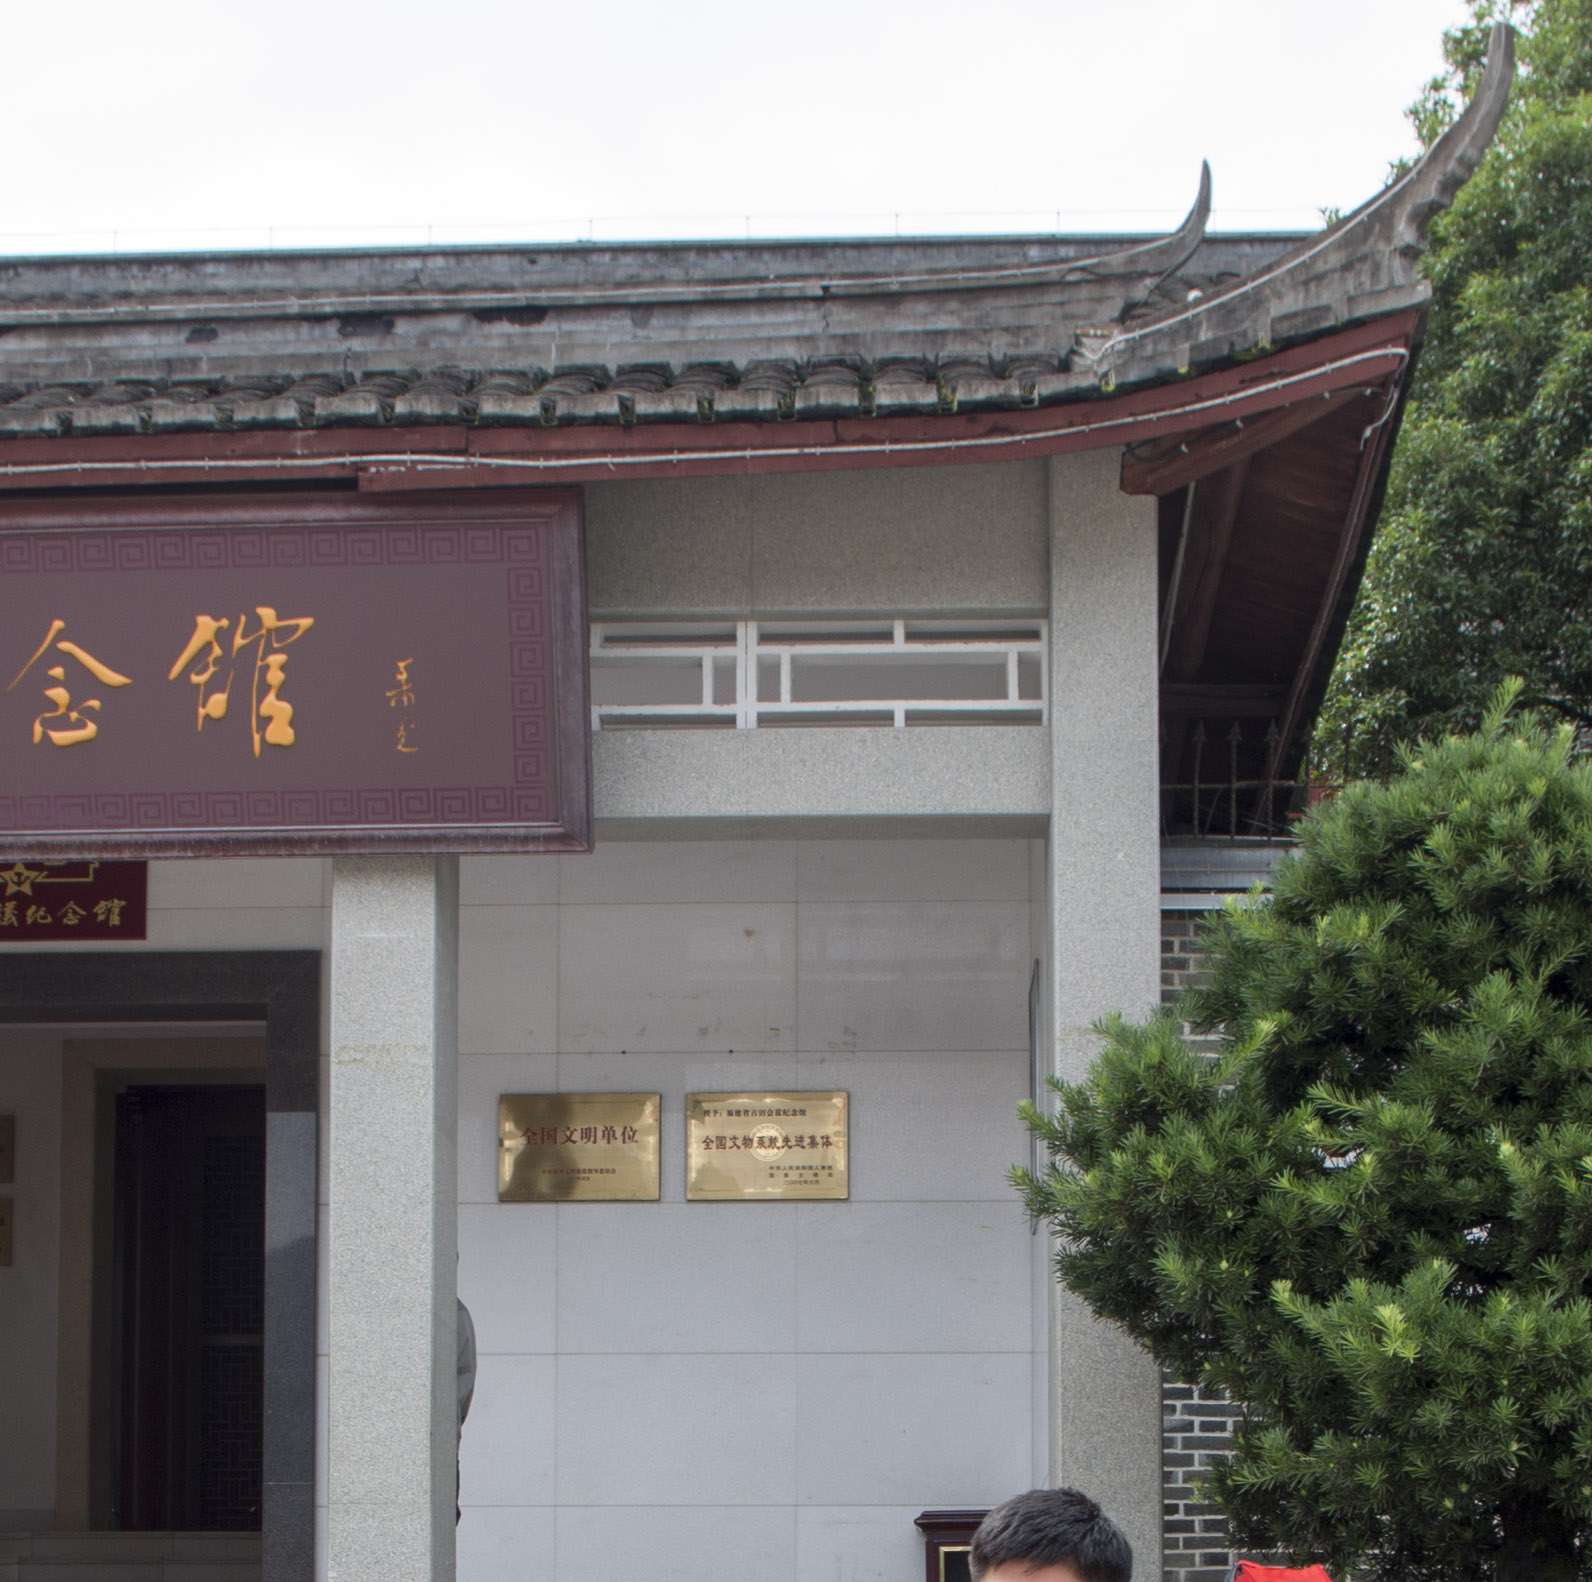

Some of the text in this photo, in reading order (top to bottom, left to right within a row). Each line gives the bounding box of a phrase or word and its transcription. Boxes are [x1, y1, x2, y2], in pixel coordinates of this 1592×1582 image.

[520, 1125, 639, 1145] 全国文明单位
[702, 1134, 833, 1150] 全国文物系统先进集体
